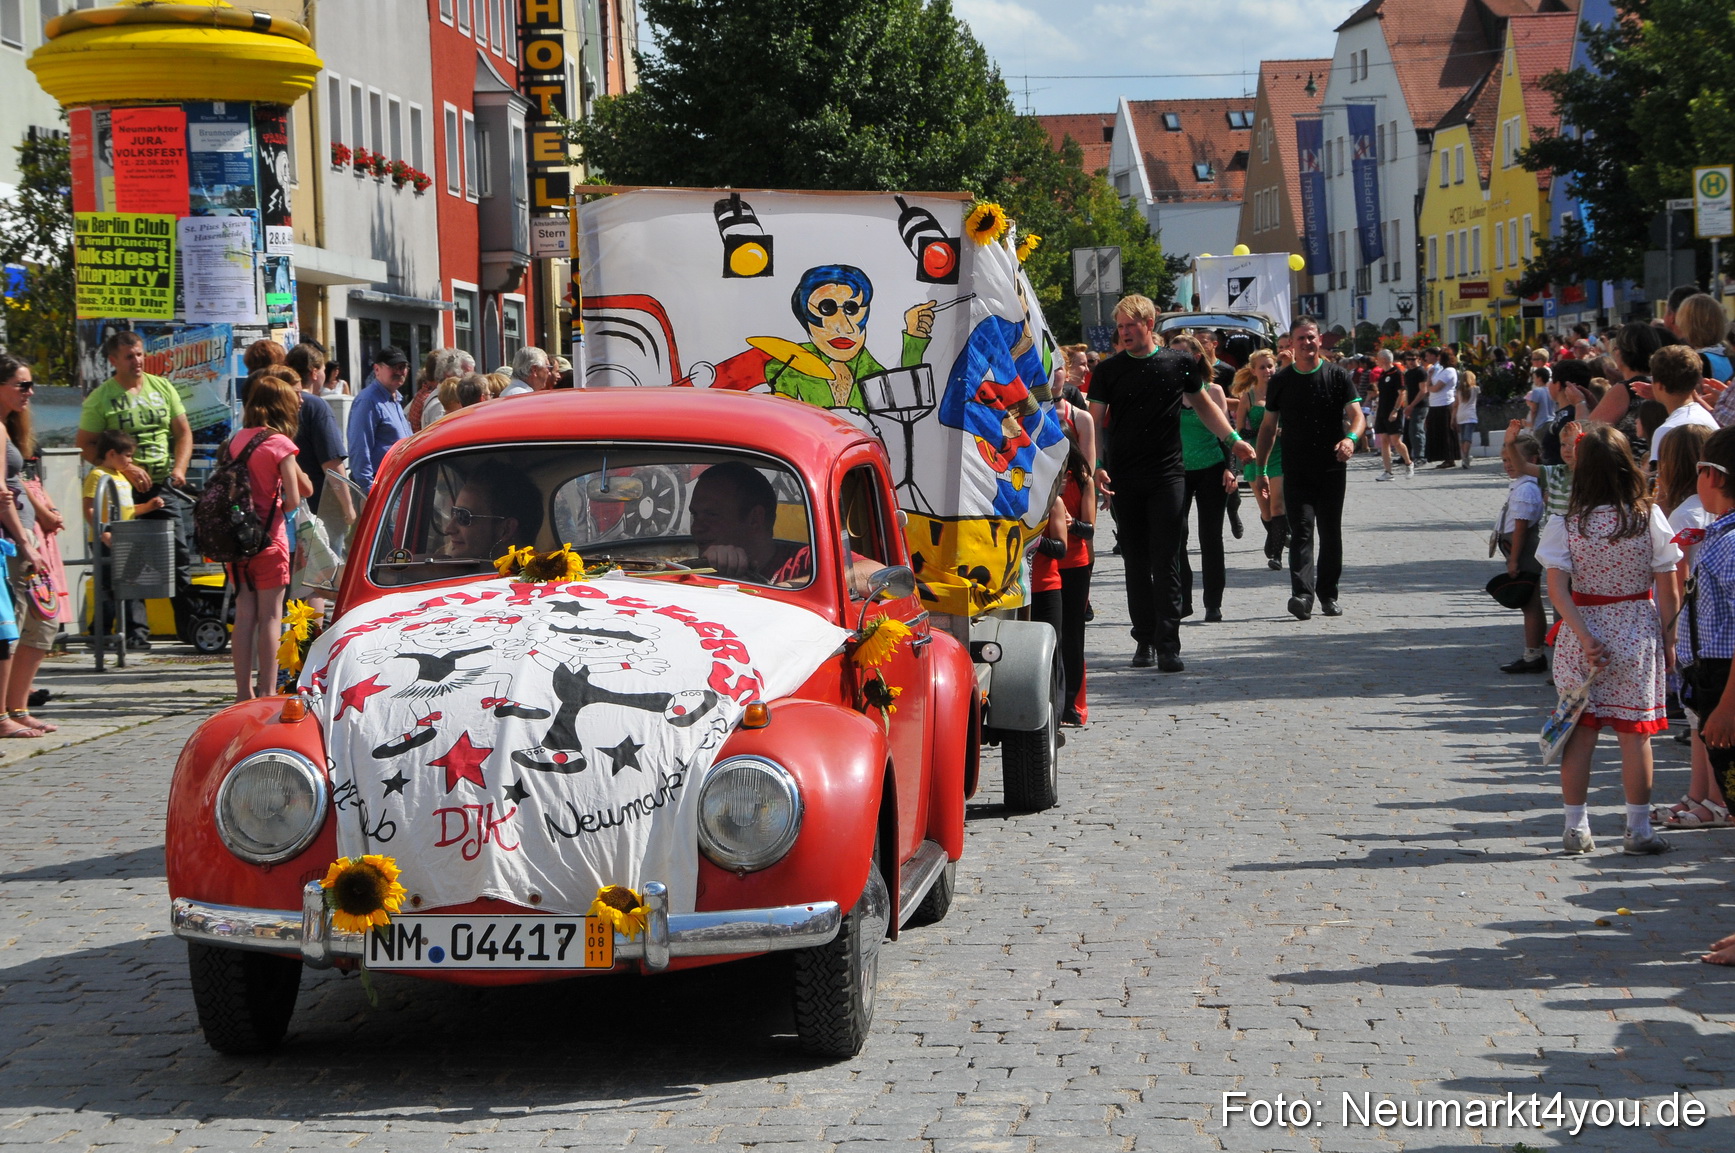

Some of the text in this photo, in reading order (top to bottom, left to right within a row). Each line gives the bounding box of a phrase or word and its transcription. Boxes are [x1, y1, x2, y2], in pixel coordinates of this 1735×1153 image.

[525, 0, 568, 208] HOTEL
[118, 125, 179, 134] Neumarkter
[130, 136, 167, 146] JURA-
[115, 147, 185, 158] VOLKSFEST
[1362, 164, 1376, 221] RUPPERT
[91, 216, 130, 234] Berlin
[134, 217, 170, 236] Club
[199, 223, 220, 232] Pius
[533, 219, 570, 228] Altstadthote
[538, 229, 566, 238] Stern
[113, 236, 167, 250] Dancing
[100, 296, 136, 307] 24.00
[140, 297, 168, 308] Uhr
[432, 756, 689, 861] DJK Neumarkt
[370, 923, 577, 962] NM 04417
[588, 936, 605, 948] 08
[588, 950, 605, 962] 11
